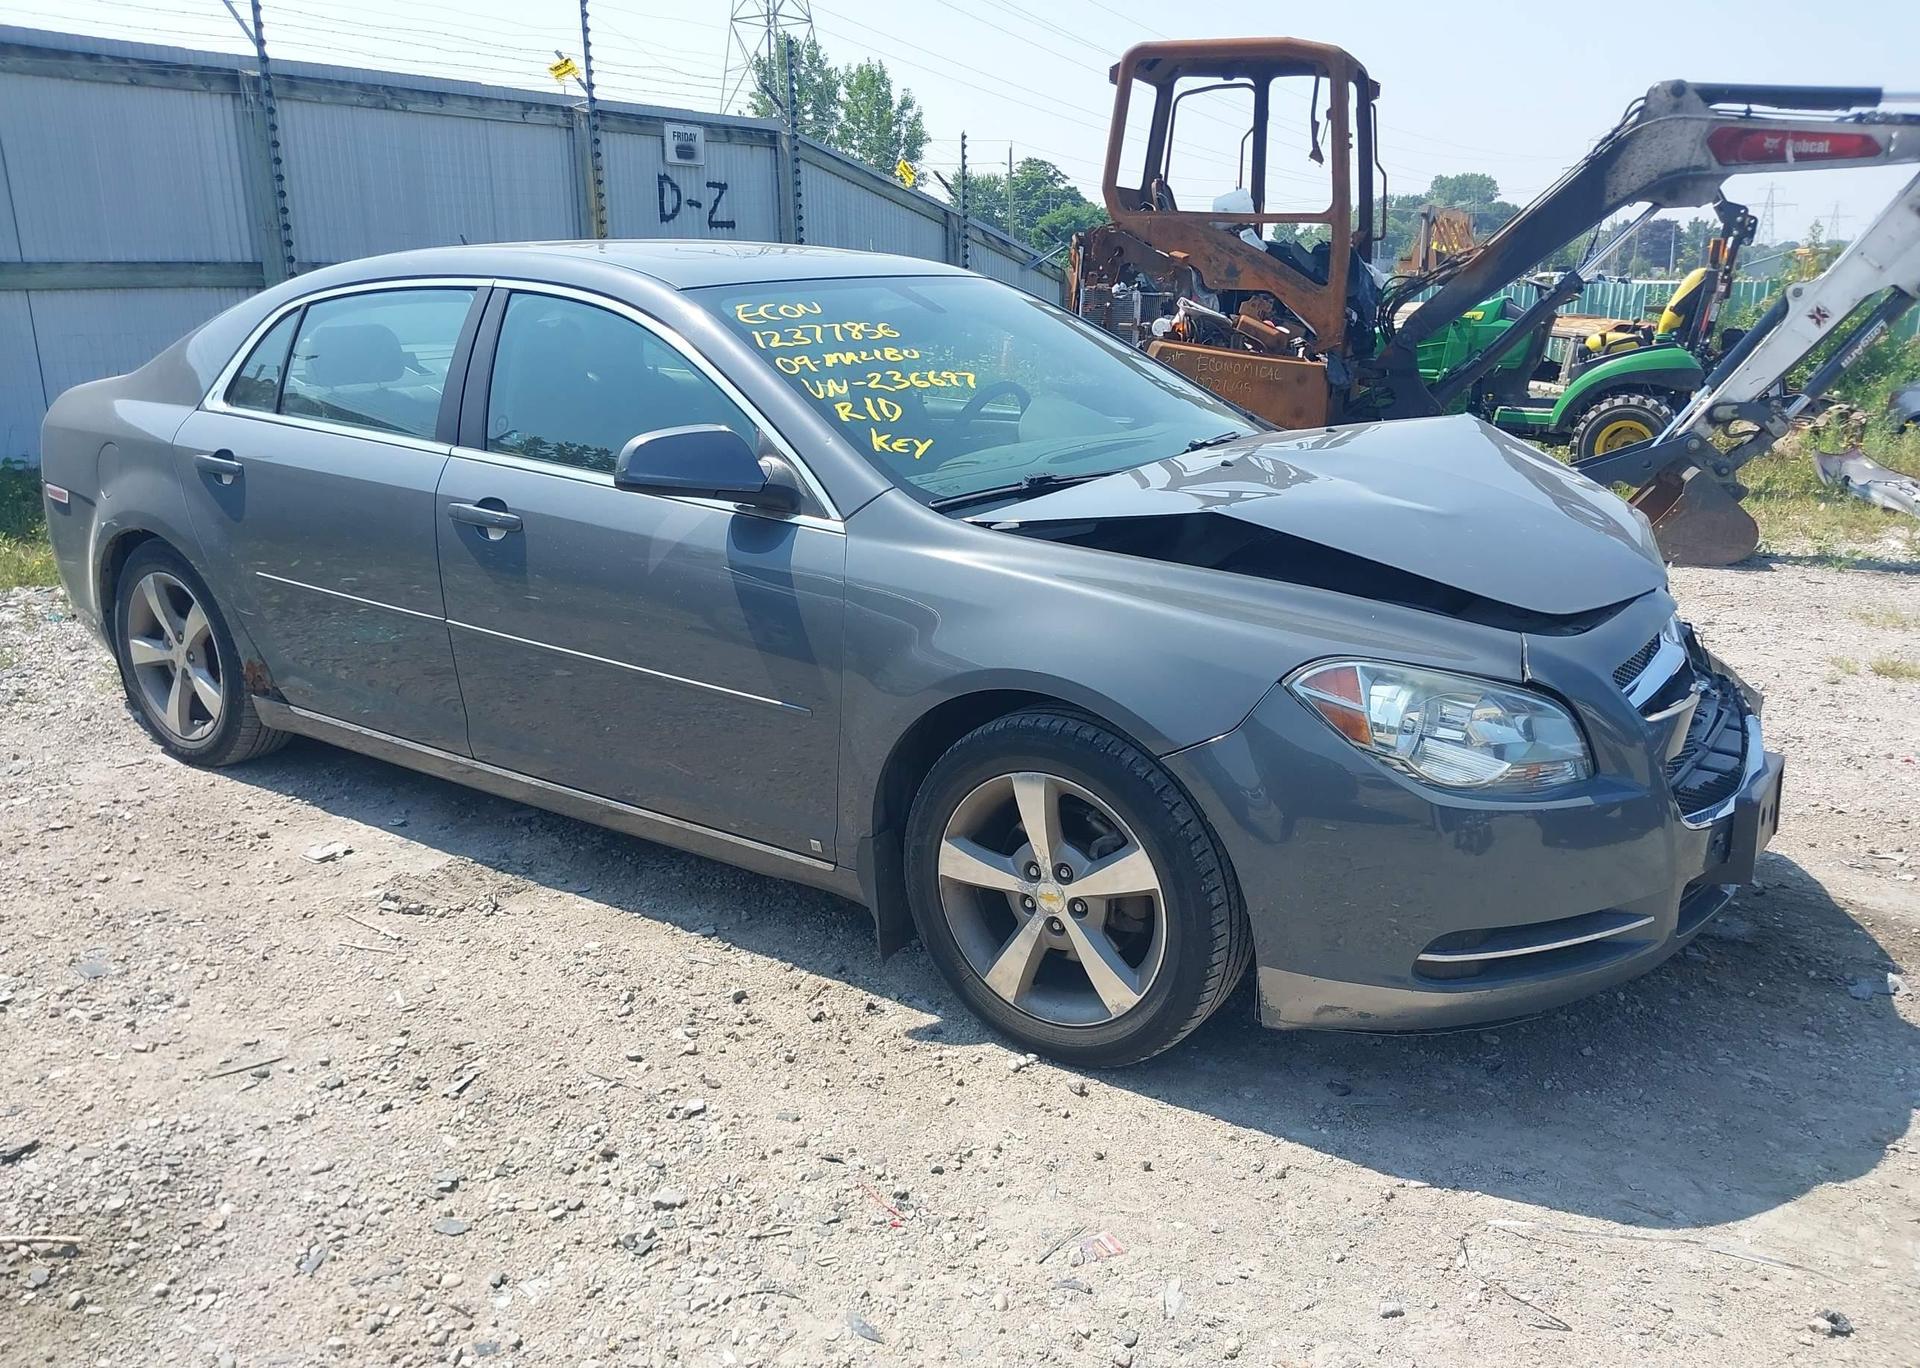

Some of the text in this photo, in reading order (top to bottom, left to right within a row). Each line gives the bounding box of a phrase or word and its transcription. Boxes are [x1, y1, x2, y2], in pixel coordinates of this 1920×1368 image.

[672, 131, 697, 143] FRIDAY
[658, 172, 736, 230] D-Z
[735, 301, 822, 324] ECON
[752, 320, 901, 349] 12377856
[1197, 354, 1282, 381] ECONOMICAL
[870, 427, 934, 459] KEY
